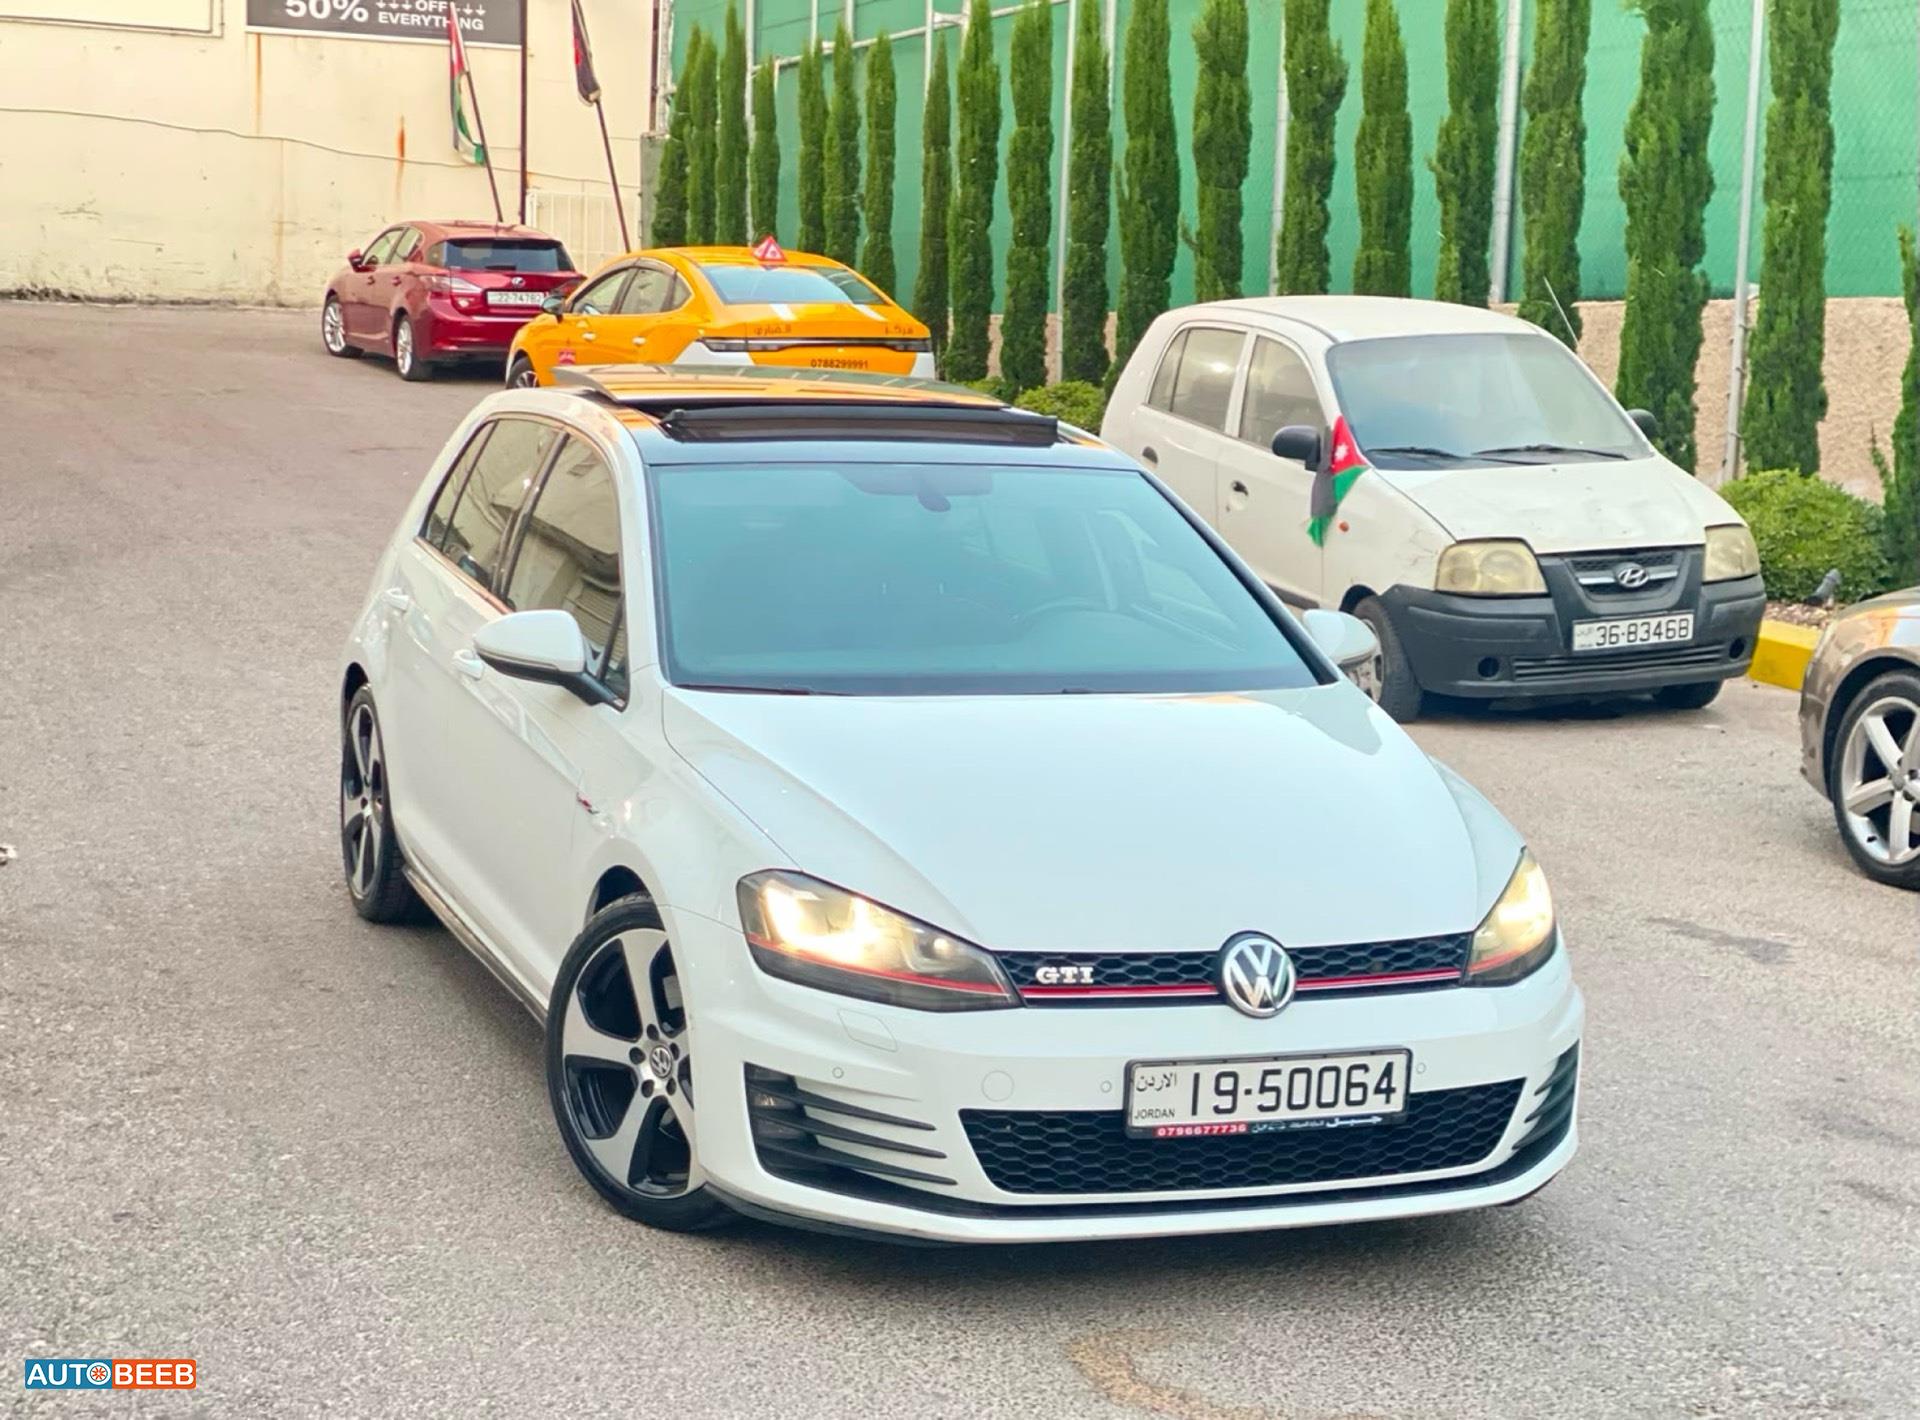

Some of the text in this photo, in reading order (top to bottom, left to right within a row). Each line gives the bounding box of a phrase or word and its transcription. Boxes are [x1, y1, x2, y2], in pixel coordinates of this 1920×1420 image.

[285, 0, 369, 22] 50%
[415, 0, 448, 12] OFF
[378, 11, 484, 30] EVERYTHNG
[1035, 966, 1094, 984] GTI
[1134, 1108, 1175, 1119] JORDAN
